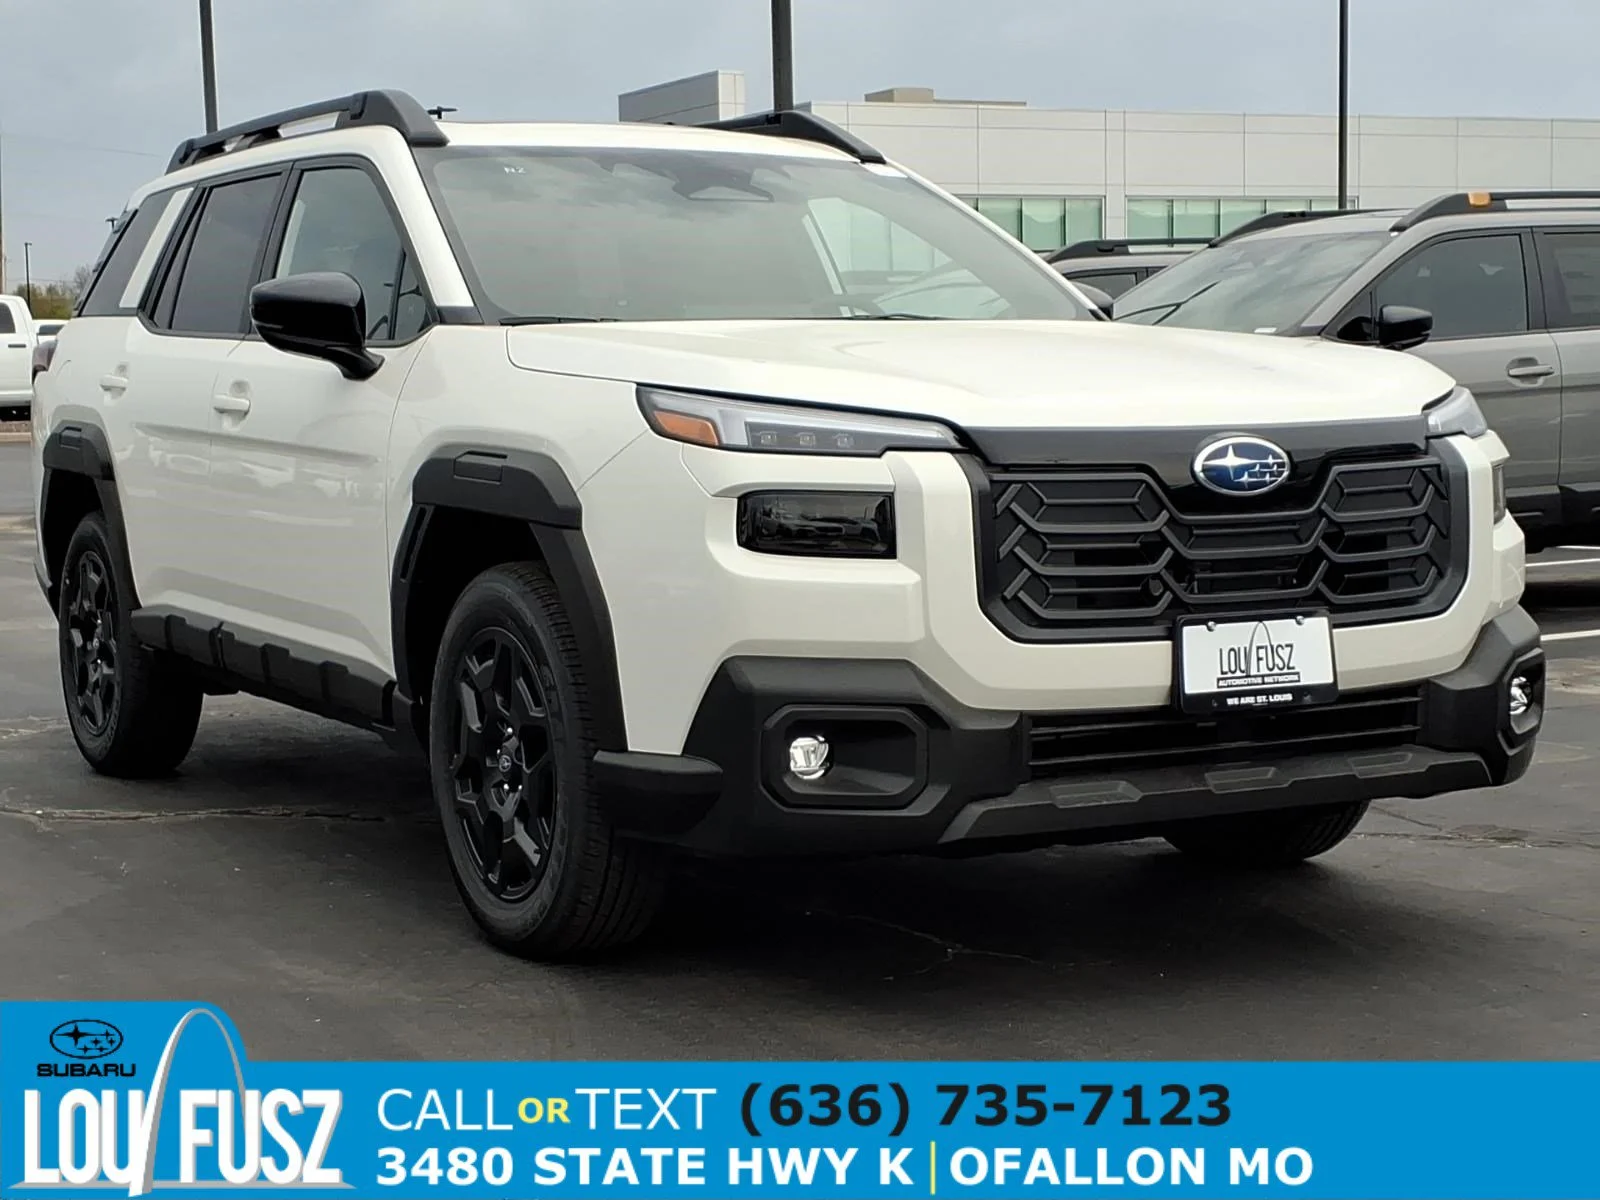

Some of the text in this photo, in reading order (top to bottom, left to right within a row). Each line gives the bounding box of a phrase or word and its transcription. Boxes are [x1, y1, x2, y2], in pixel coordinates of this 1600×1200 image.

[1219, 643, 1296, 675] LOU FUSZ
[1218, 674, 1299, 687] AUTOMOTIVE NETWORK
[1226, 693, 1293, 705] WE ARE ST. LOUIS
